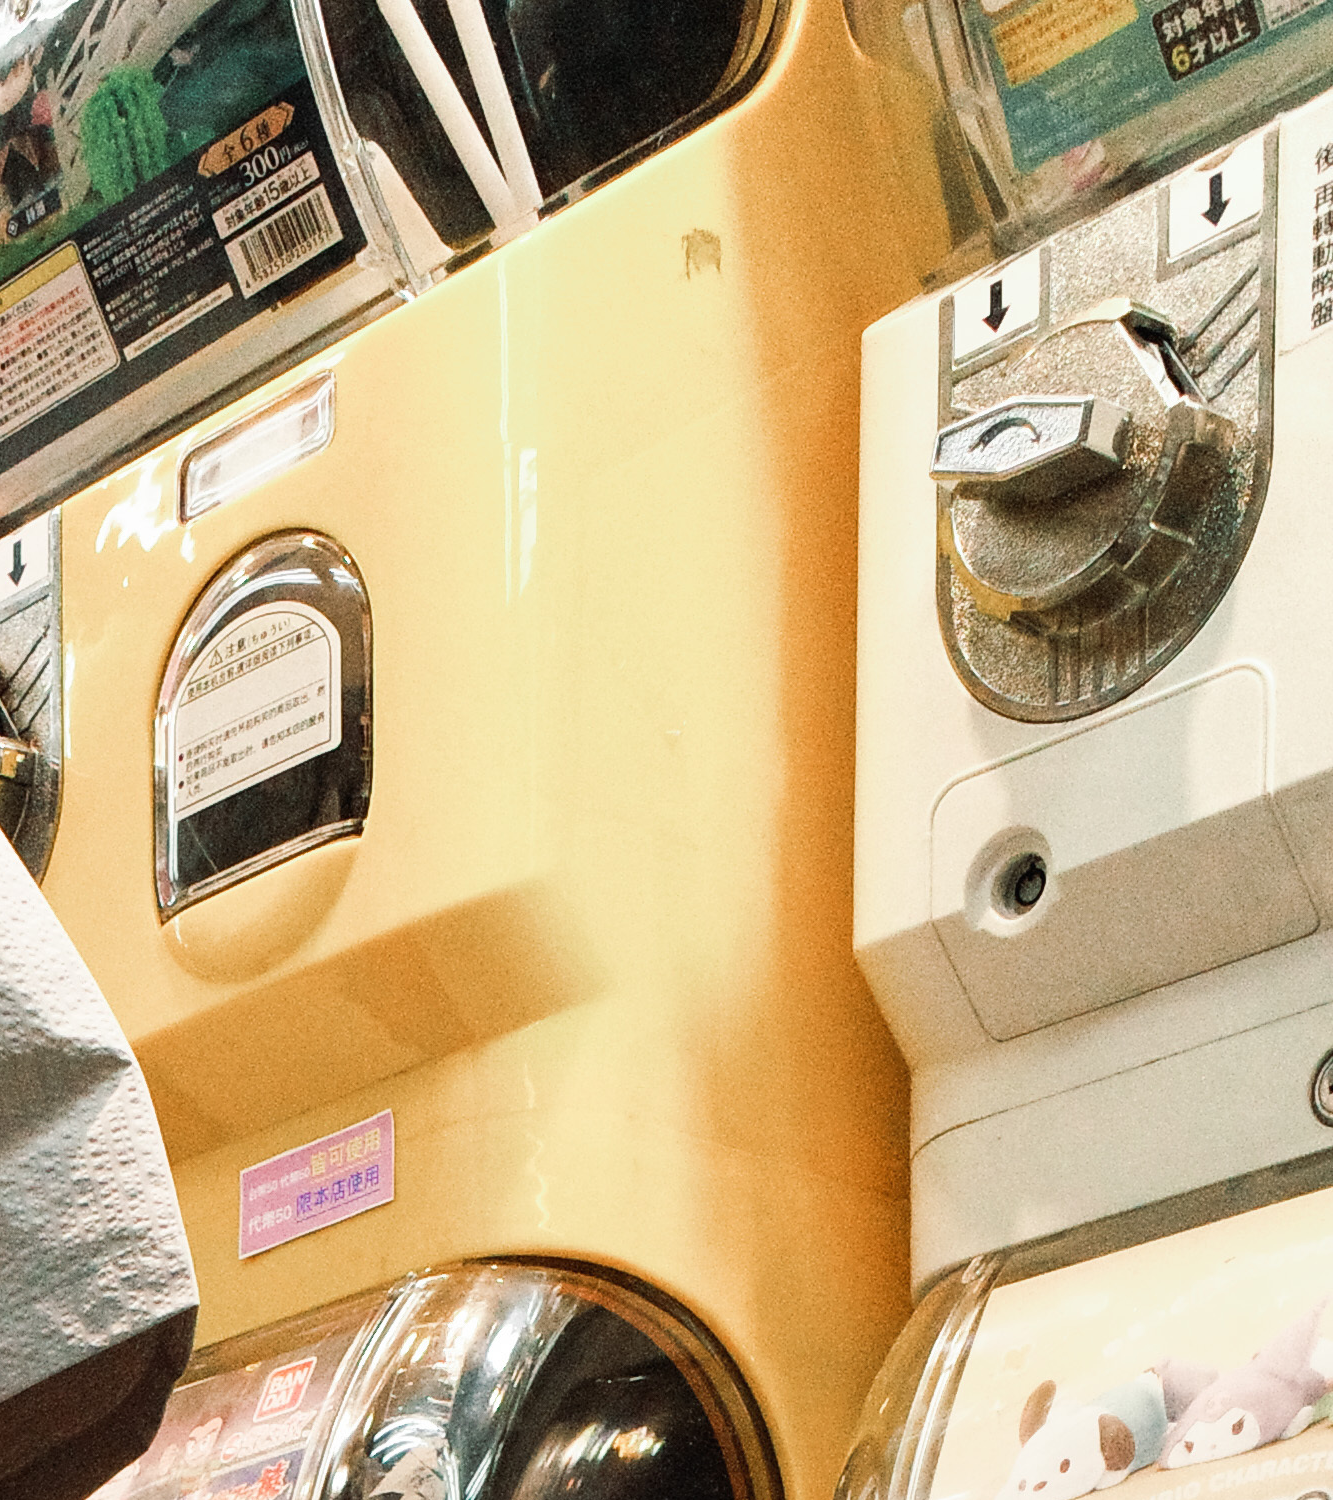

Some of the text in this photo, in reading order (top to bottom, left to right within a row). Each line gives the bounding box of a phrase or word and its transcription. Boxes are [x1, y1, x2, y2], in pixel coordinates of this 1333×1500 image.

[1161, 0, 1245, 43] 対象年
[1171, 27, 1250, 73] 6才以上
[239, 145, 293, 187] 300円
[297, 1164, 379, 1217] 限本店使用
[262, 1387, 293, 1411] DAI
[270, 1368, 309, 1393] BAN
